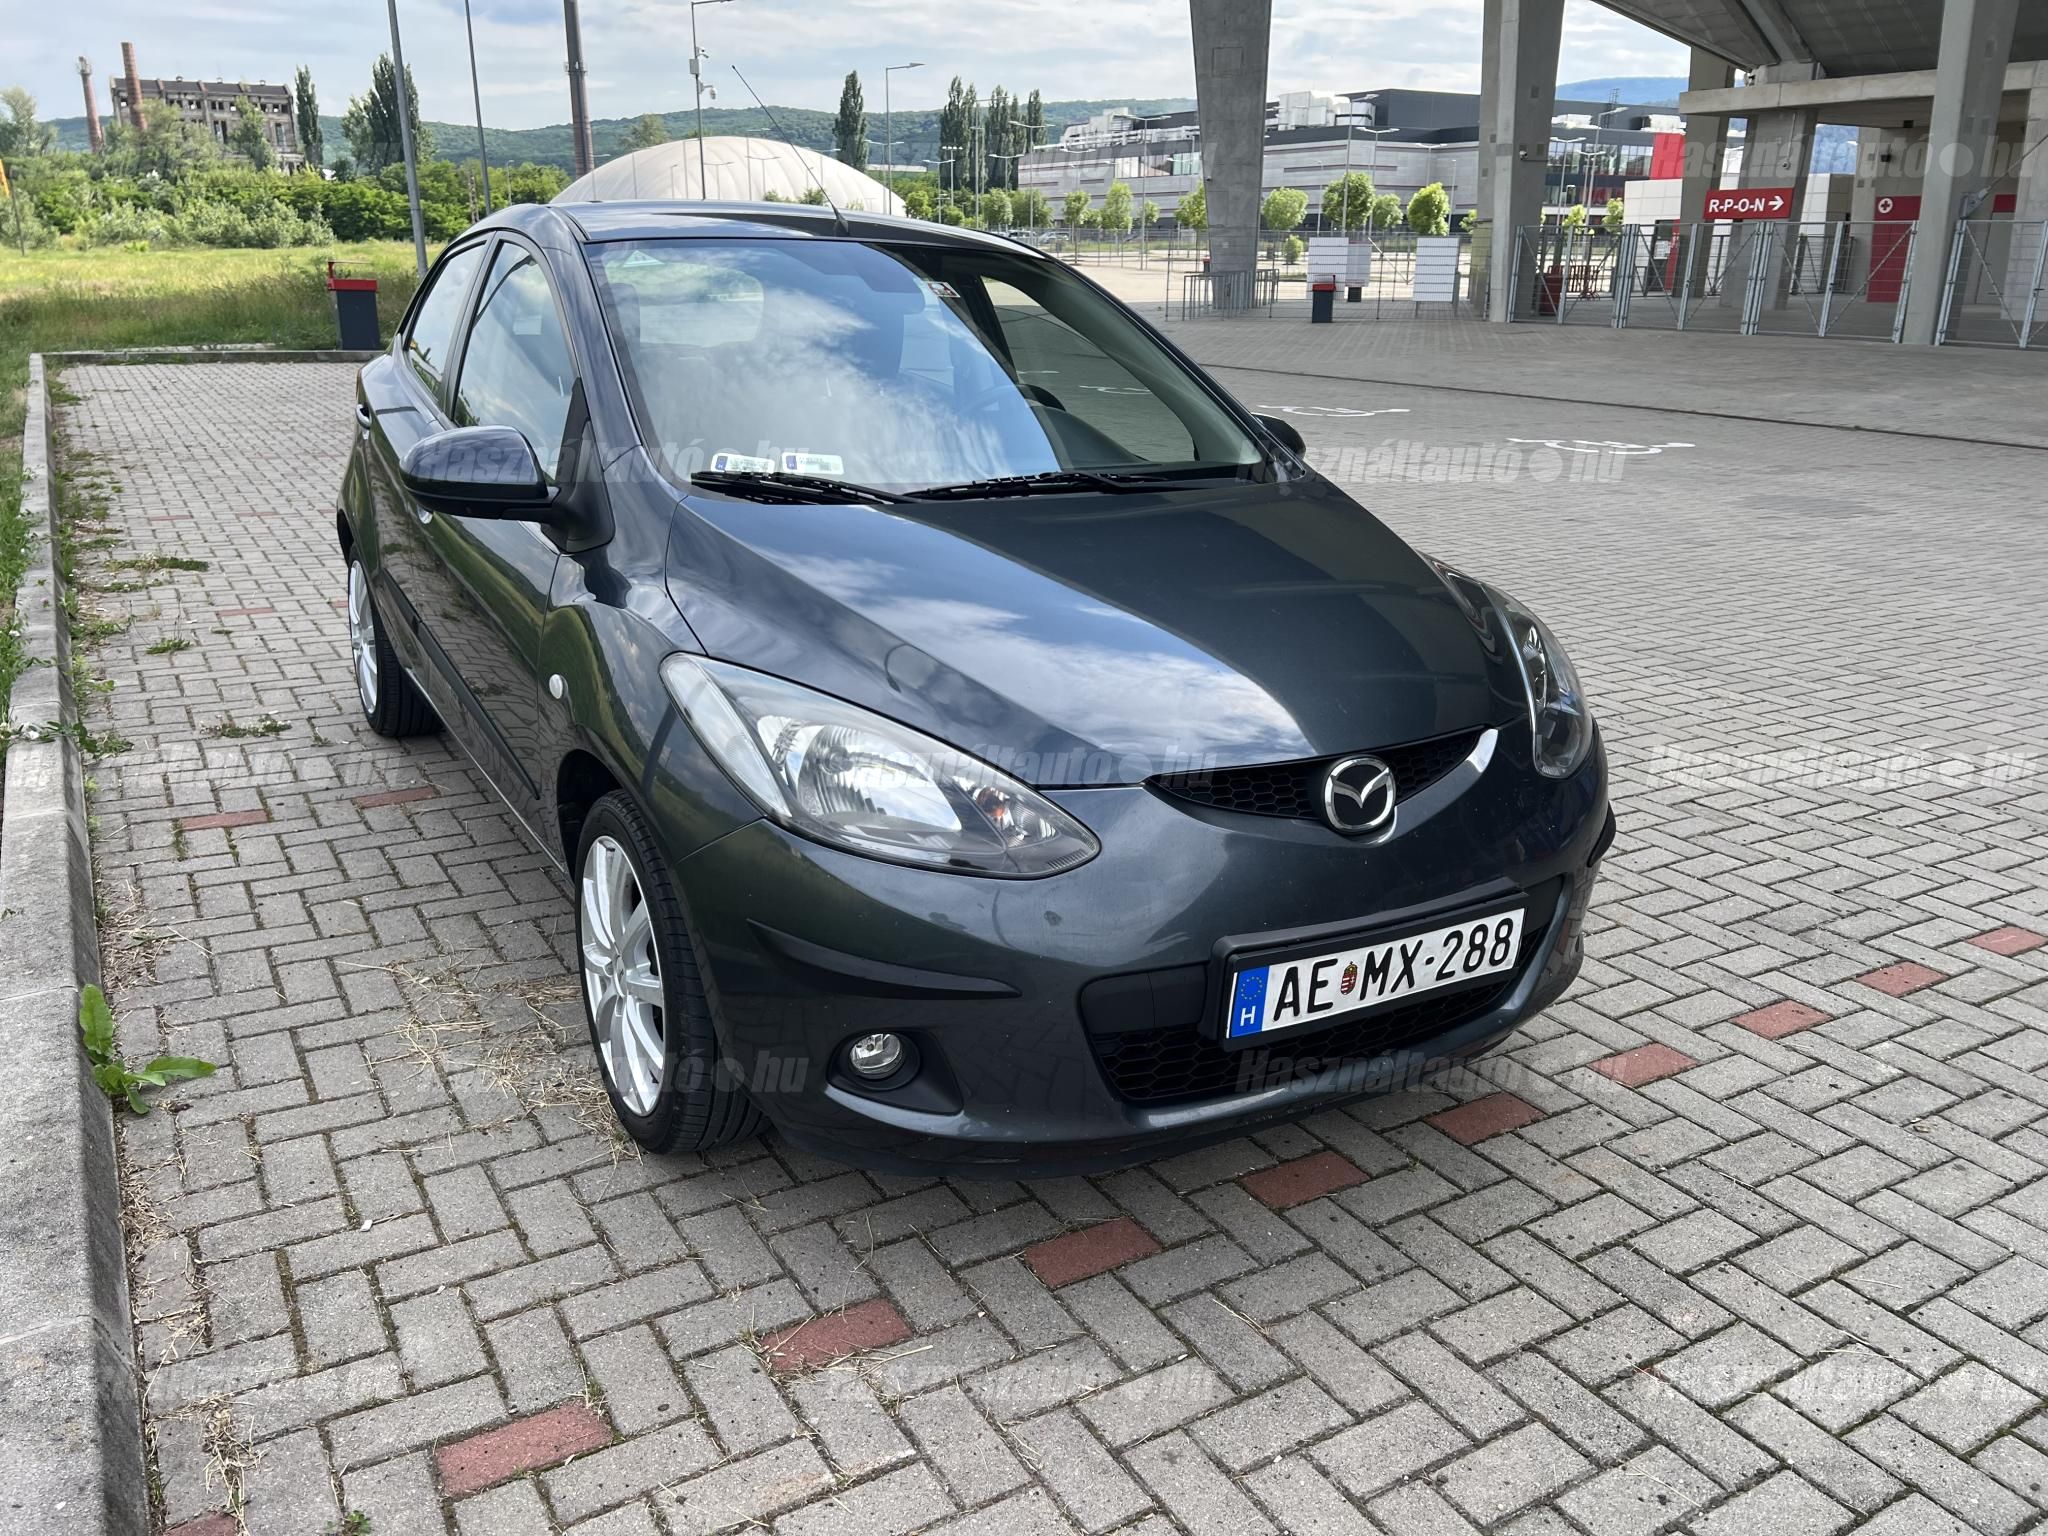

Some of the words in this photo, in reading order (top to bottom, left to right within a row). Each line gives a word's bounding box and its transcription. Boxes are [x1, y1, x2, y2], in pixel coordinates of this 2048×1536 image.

[1708, 197, 1766, 213] R-P-O-N
[1240, 1006, 1256, 1027] H
[1273, 958, 1338, 1022] AE
[1359, 917, 1515, 1001] MX-288
